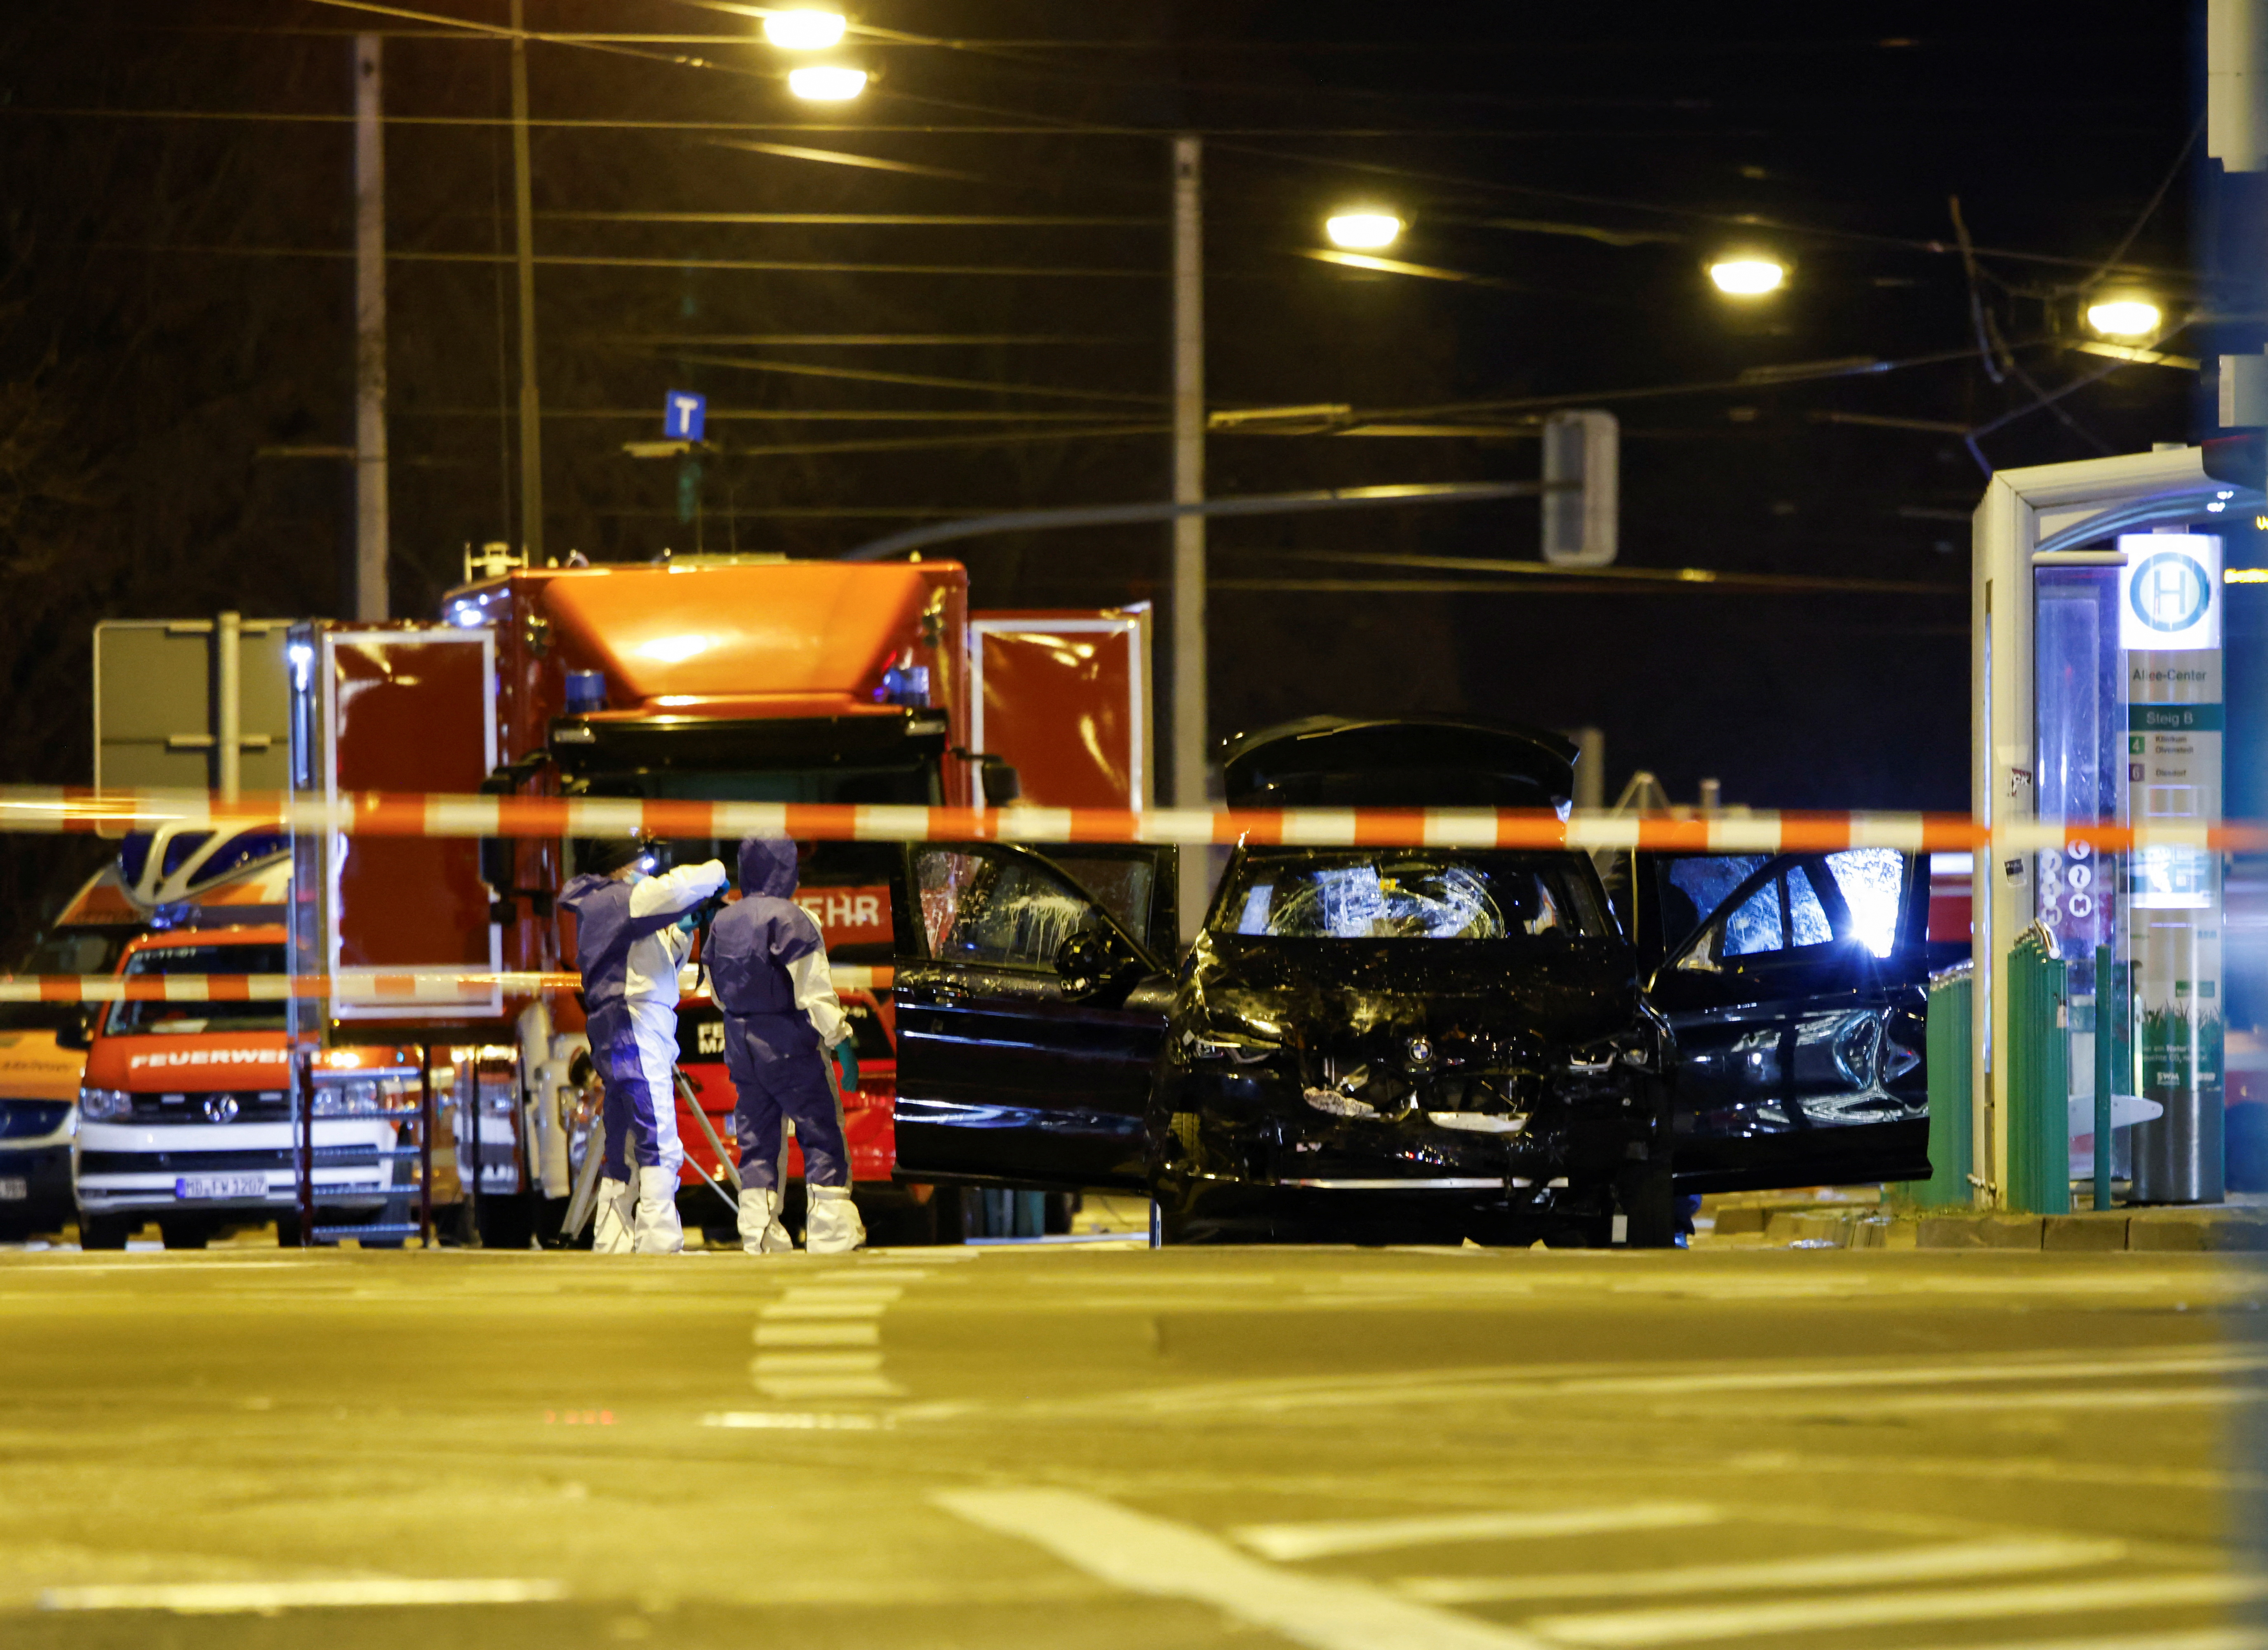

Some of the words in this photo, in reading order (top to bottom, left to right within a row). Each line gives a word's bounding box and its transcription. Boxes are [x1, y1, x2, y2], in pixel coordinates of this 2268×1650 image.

[674, 397, 698, 433] T
[2154, 570, 2186, 615] H
[2147, 711, 2179, 727] Steig
[2183, 711, 2193, 725] B
[2132, 738, 2140, 751] 4
[2133, 765, 2140, 781] 6
[793, 896, 880, 927] EHR
